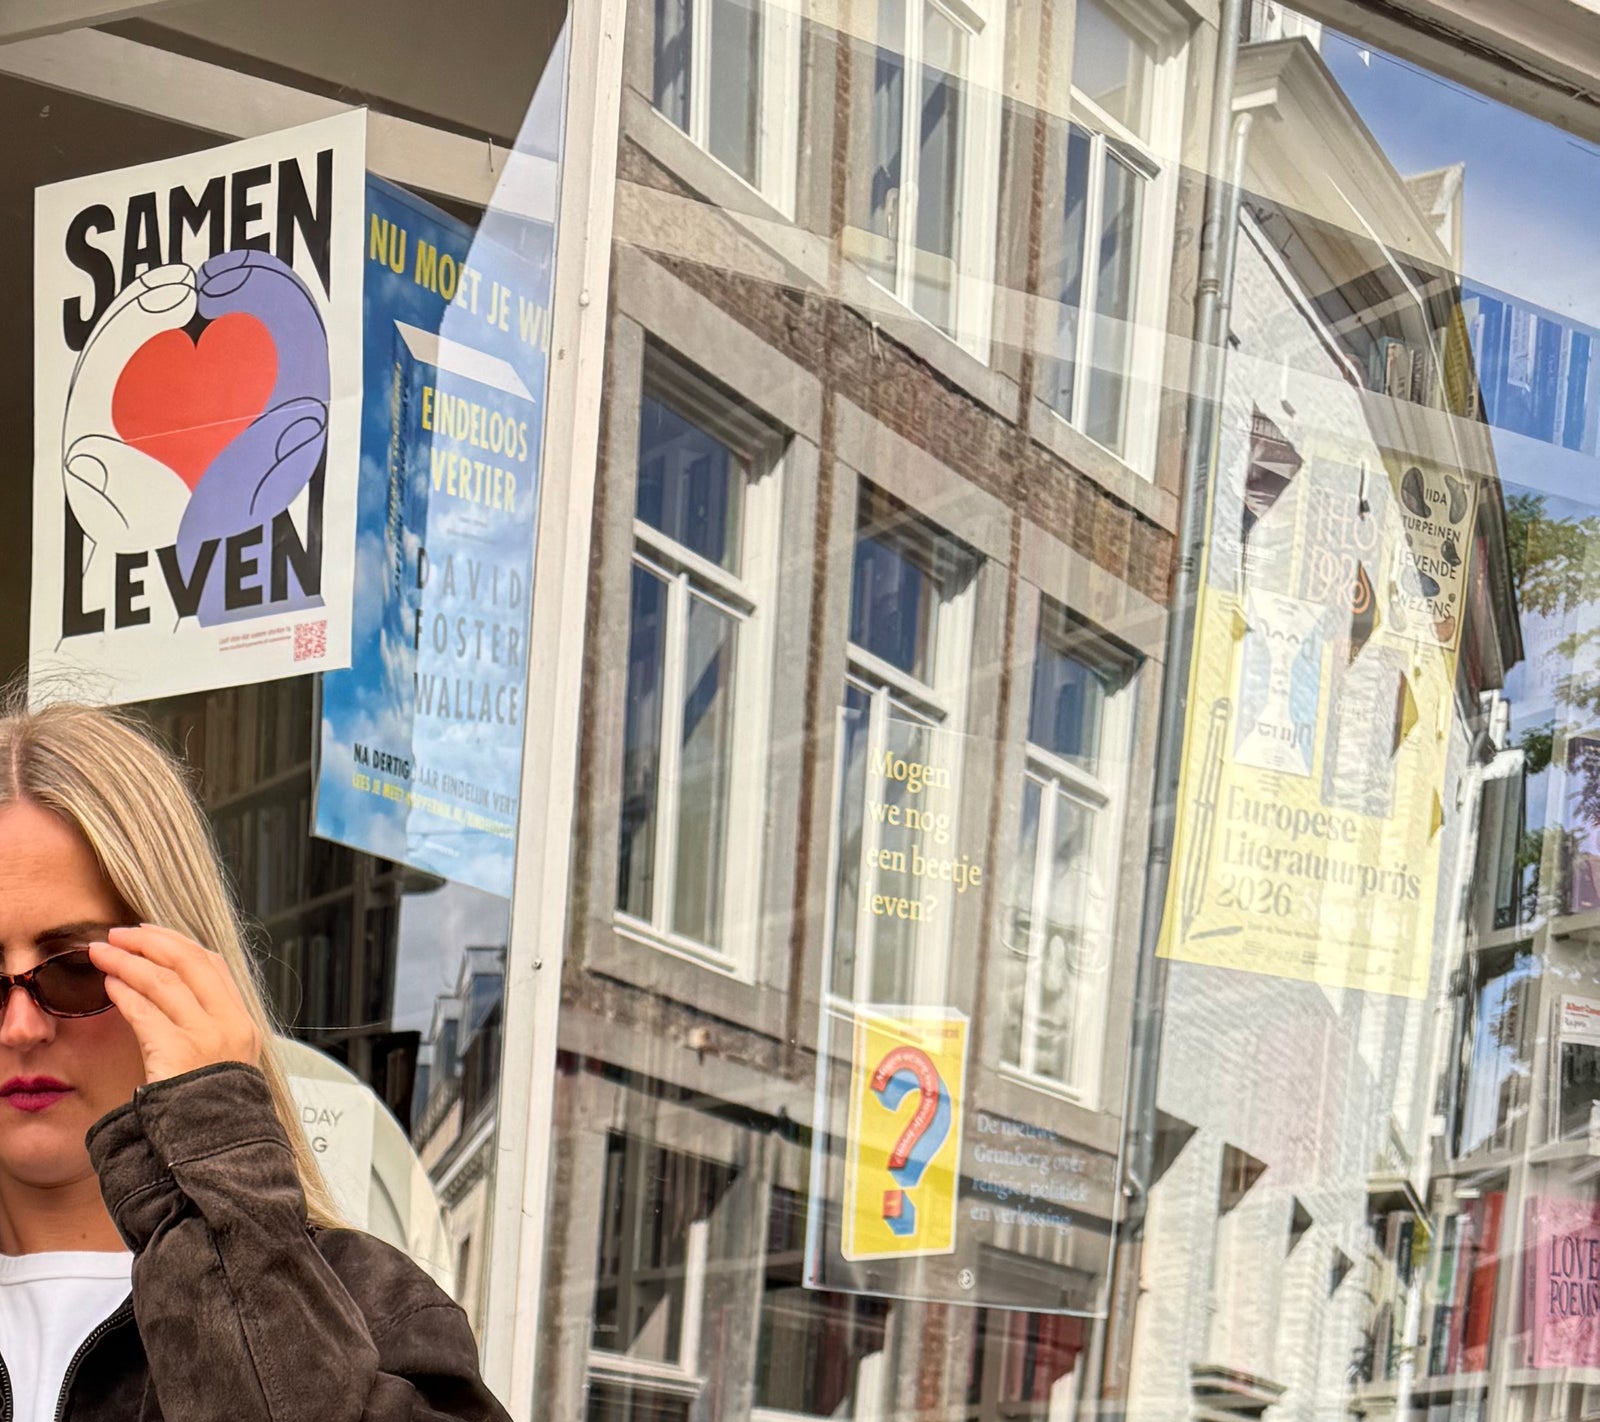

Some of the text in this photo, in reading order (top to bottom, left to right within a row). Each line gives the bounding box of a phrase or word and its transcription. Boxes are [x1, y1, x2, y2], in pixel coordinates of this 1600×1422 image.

[63, 148, 334, 352] SAMEN
[370, 214, 406, 273] NU
[415, 240, 482, 314] MOET
[487, 282, 512, 332] JE
[422, 386, 528, 462] EINDELOOS
[430, 448, 516, 512] VERTIER
[1425, 488, 1448, 506] IIDA
[62, 432, 325, 638] LEVEN
[1402, 515, 1461, 543] TURPEINEN
[417, 547, 523, 610] DAVID
[1398, 552, 1457, 580] LEVENDE
[1399, 593, 1452, 620] WEZENS
[415, 609, 520, 667] FOSTER
[413, 673, 518, 726] WALLACE
[353, 743, 369, 769] NA
[372, 750, 411, 781] DERTIG
[870, 750, 951, 793] Mogen
[866, 800, 951, 845] we nog
[1227, 785, 1357, 844] Europese
[866, 845, 983, 893] een beetje
[1223, 828, 1422, 901] Literatuurprijs
[862, 882, 937, 923] leven?
[1214, 872, 1293, 918] 2026
[303, 1106, 344, 1125] DAY
[977, 1114, 998, 1134] De
[312, 1136, 328, 1153] G
[973, 1143, 1086, 1175] Grunberg over
[970, 1207, 990, 1222] en
[1550, 1234, 1600, 1281] LOVE
